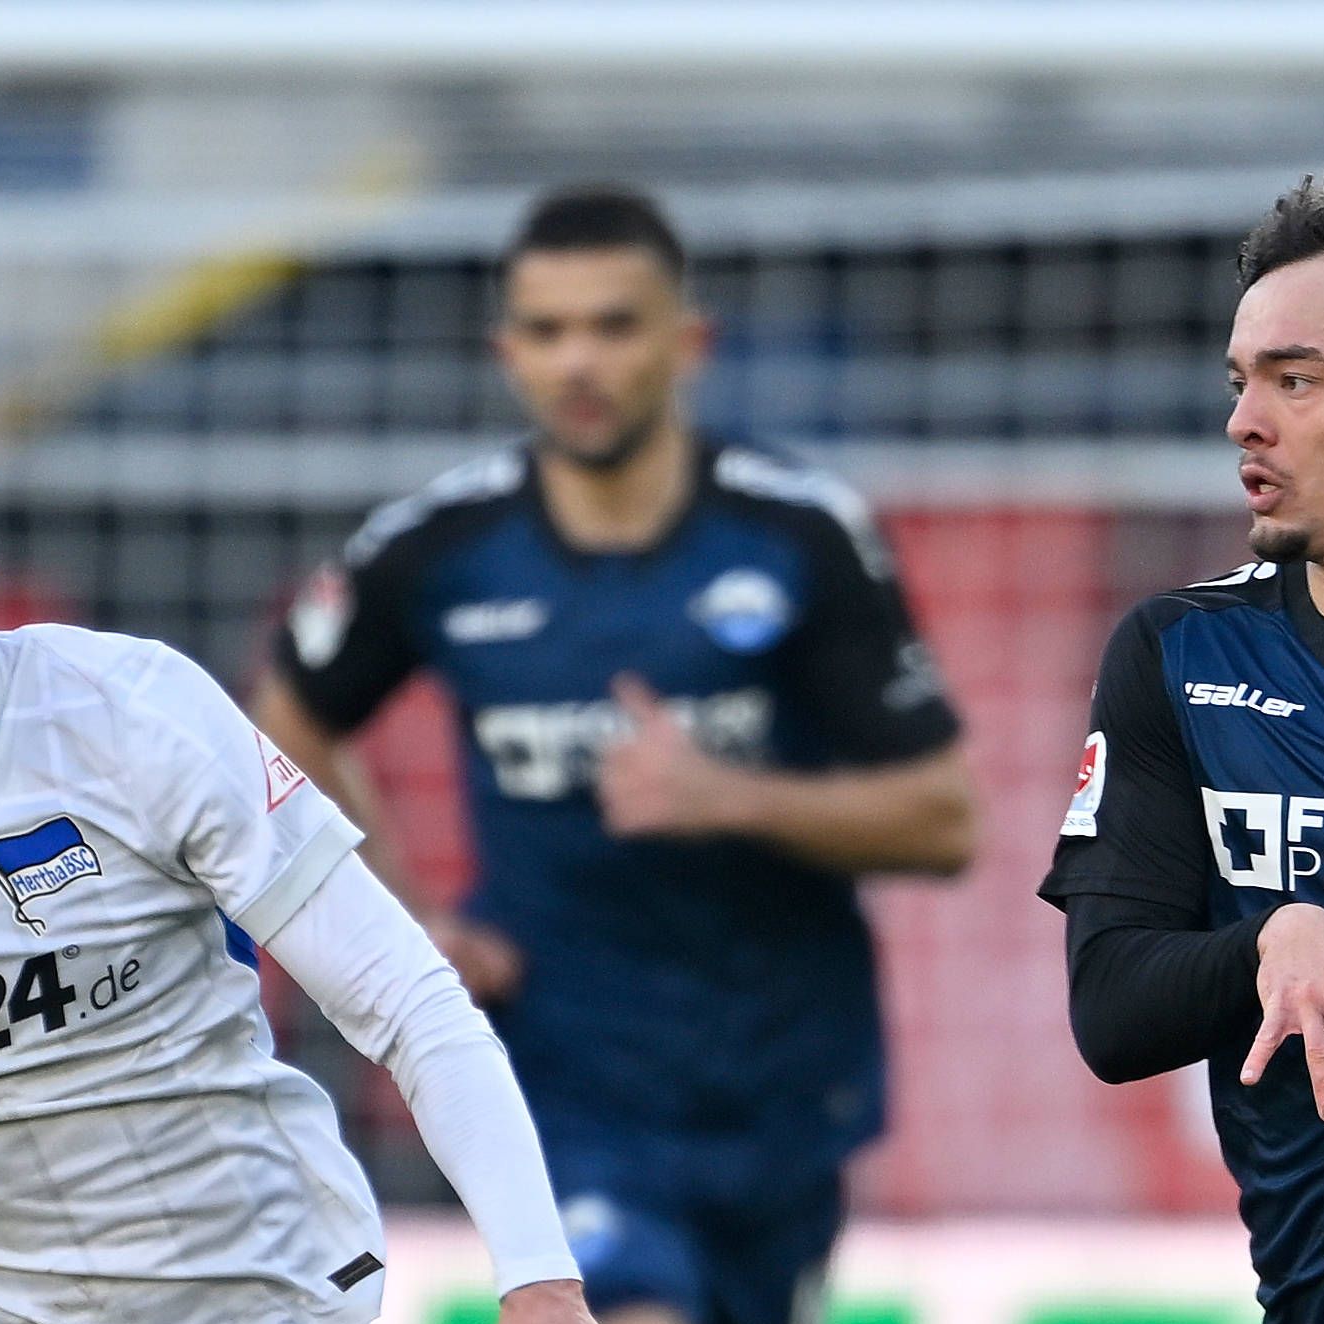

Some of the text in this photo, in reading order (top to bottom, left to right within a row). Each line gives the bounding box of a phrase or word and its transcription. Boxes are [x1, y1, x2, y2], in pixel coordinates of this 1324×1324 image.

[10, 848, 95, 897] Hertha BSC
[79, 957, 141, 1020] .de
